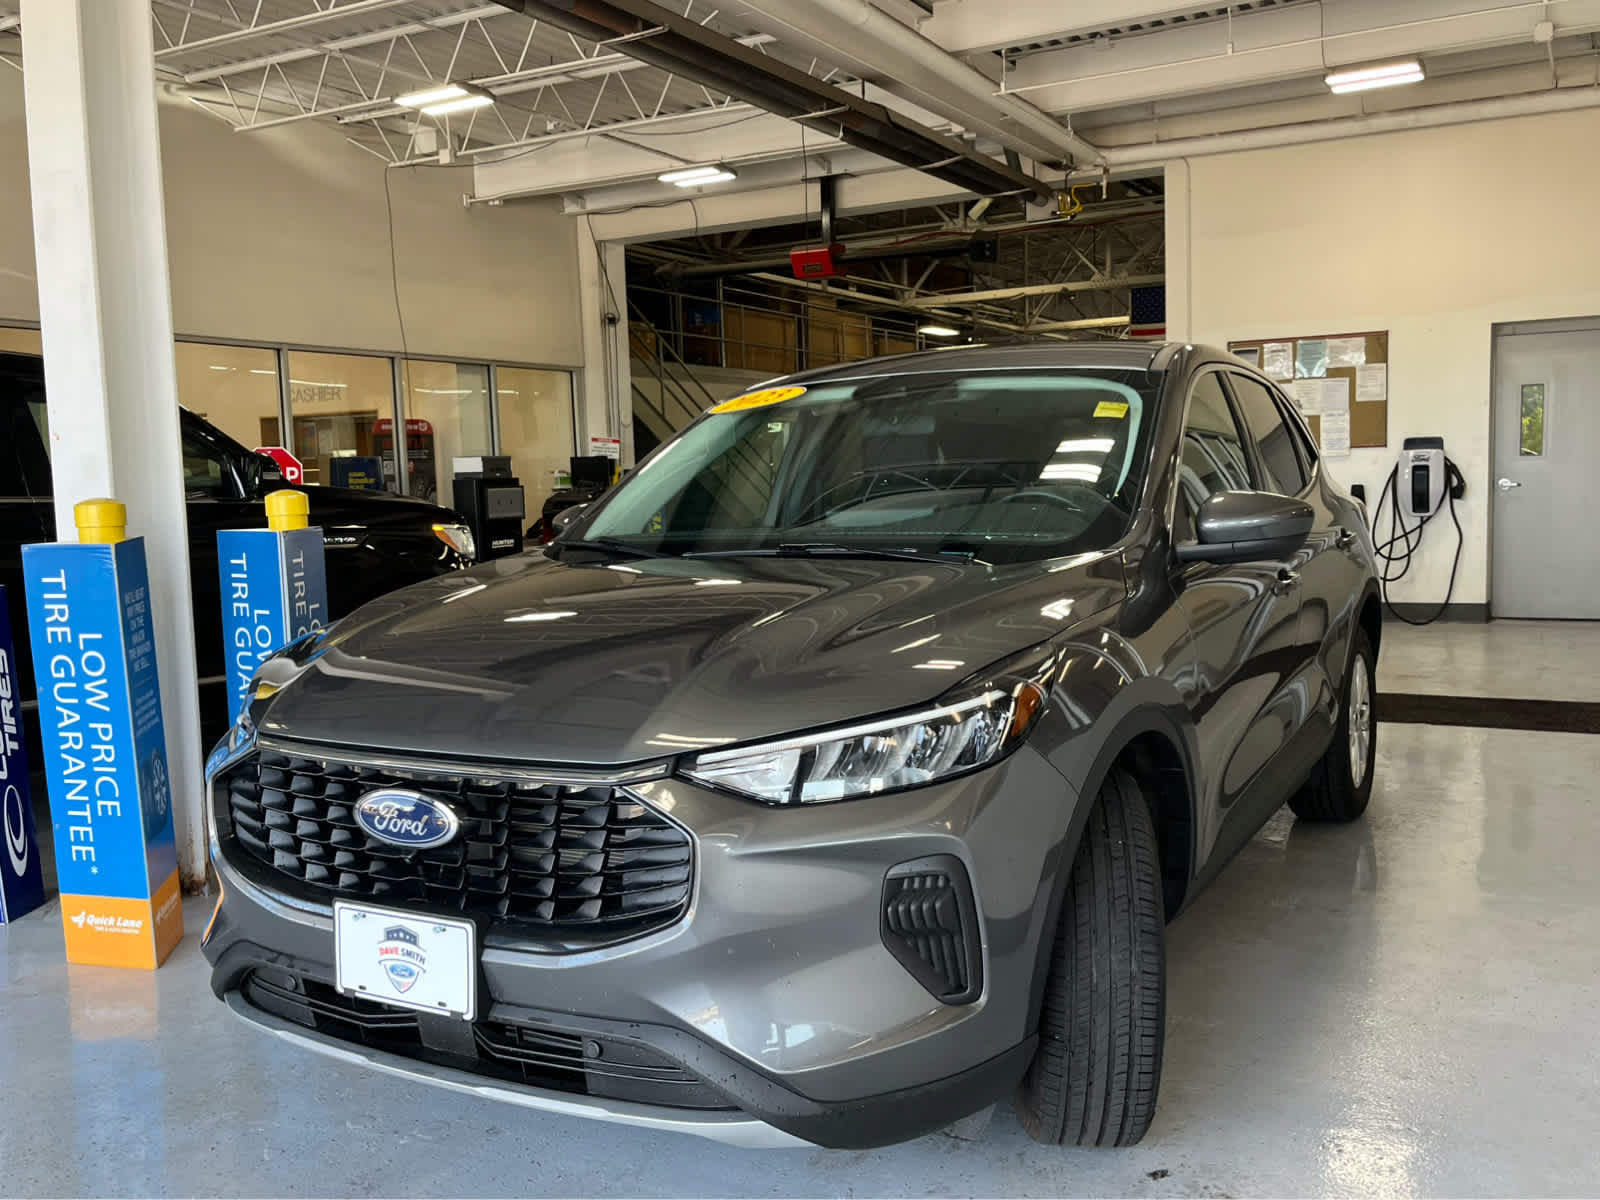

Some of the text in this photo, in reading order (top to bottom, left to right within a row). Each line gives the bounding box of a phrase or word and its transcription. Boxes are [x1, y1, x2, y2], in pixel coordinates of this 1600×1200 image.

[41, 569, 73, 645] TIRE
[292, 550, 307, 617] TIRE
[230, 552, 254, 699] TIRE GUA
[79, 632, 122, 818] LOW PRICE
[373, 801, 428, 836] Ford
[87, 914, 144, 928] Quick Lane
[379, 946, 426, 965] DAVE SMITH
